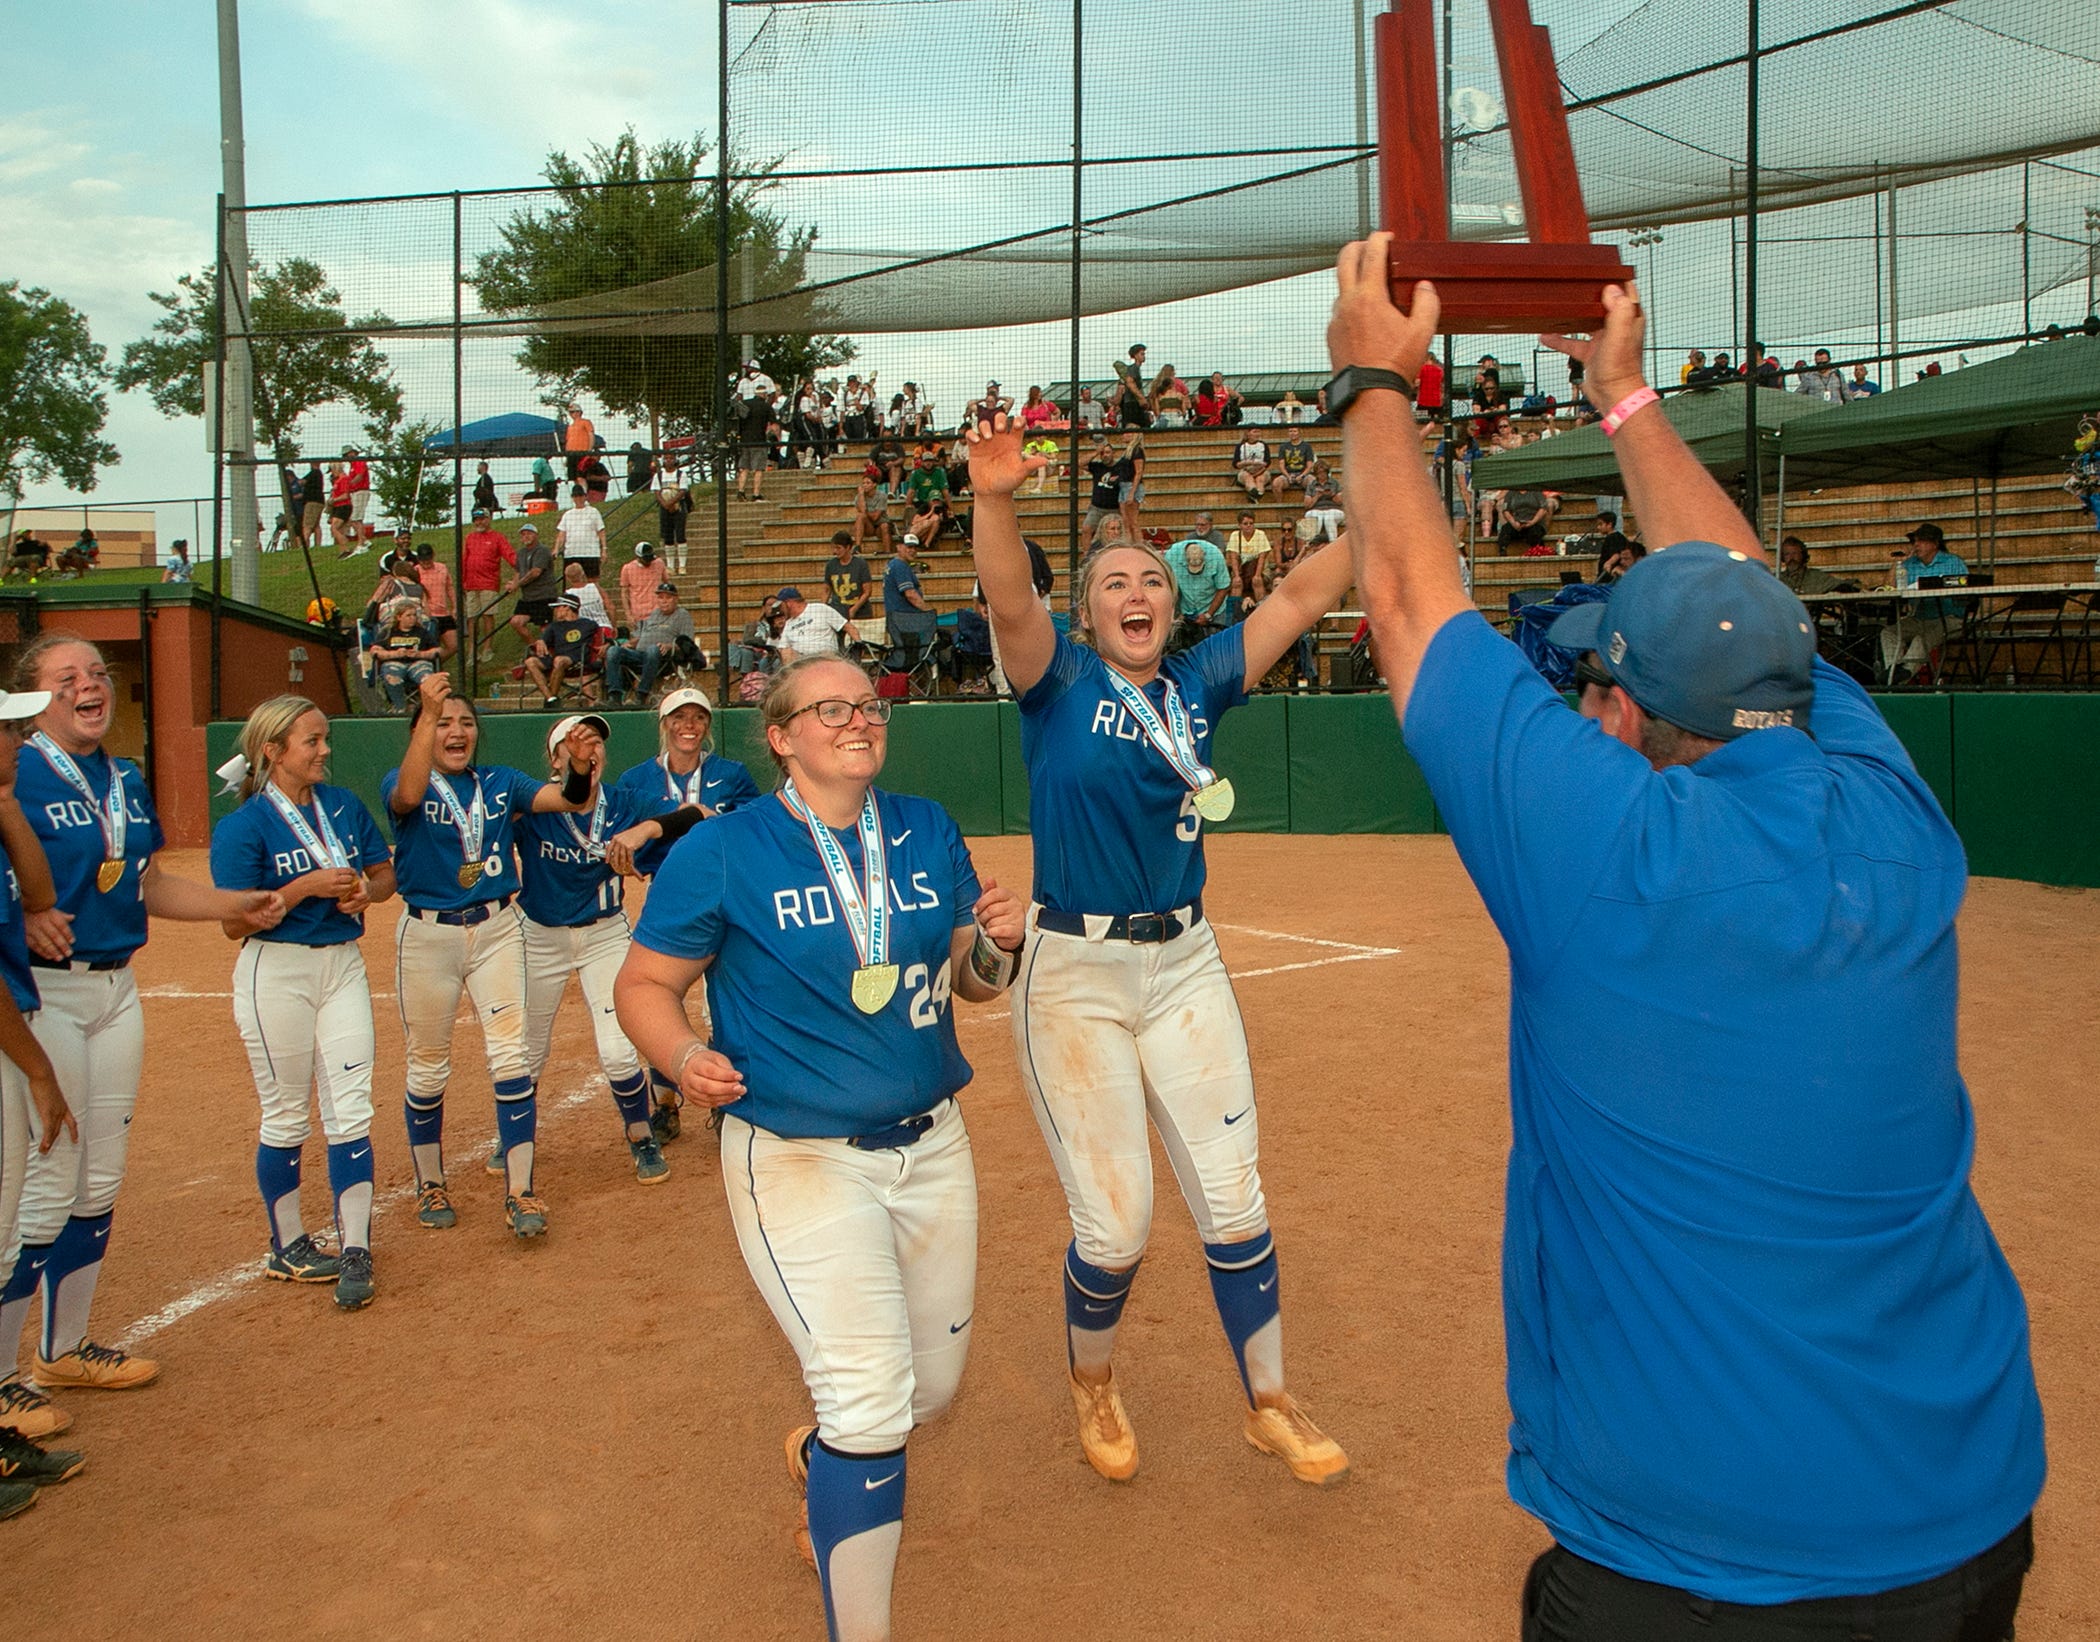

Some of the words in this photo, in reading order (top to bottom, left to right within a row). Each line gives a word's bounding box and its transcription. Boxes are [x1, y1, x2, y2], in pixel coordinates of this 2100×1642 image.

[1120, 686, 1159, 734] SOFTBALL
[287, 810, 316, 847] SOFTBALL
[424, 792, 508, 826] ROLS
[1176, 790, 1202, 842] 5
[540, 840, 601, 864] ROYA
[812, 814, 845, 875] SOFTBALL
[597, 874, 621, 911] 11
[773, 871, 940, 931] ROLS
[872, 906, 882, 965] OFTBALL
[904, 957, 951, 1029] 24
